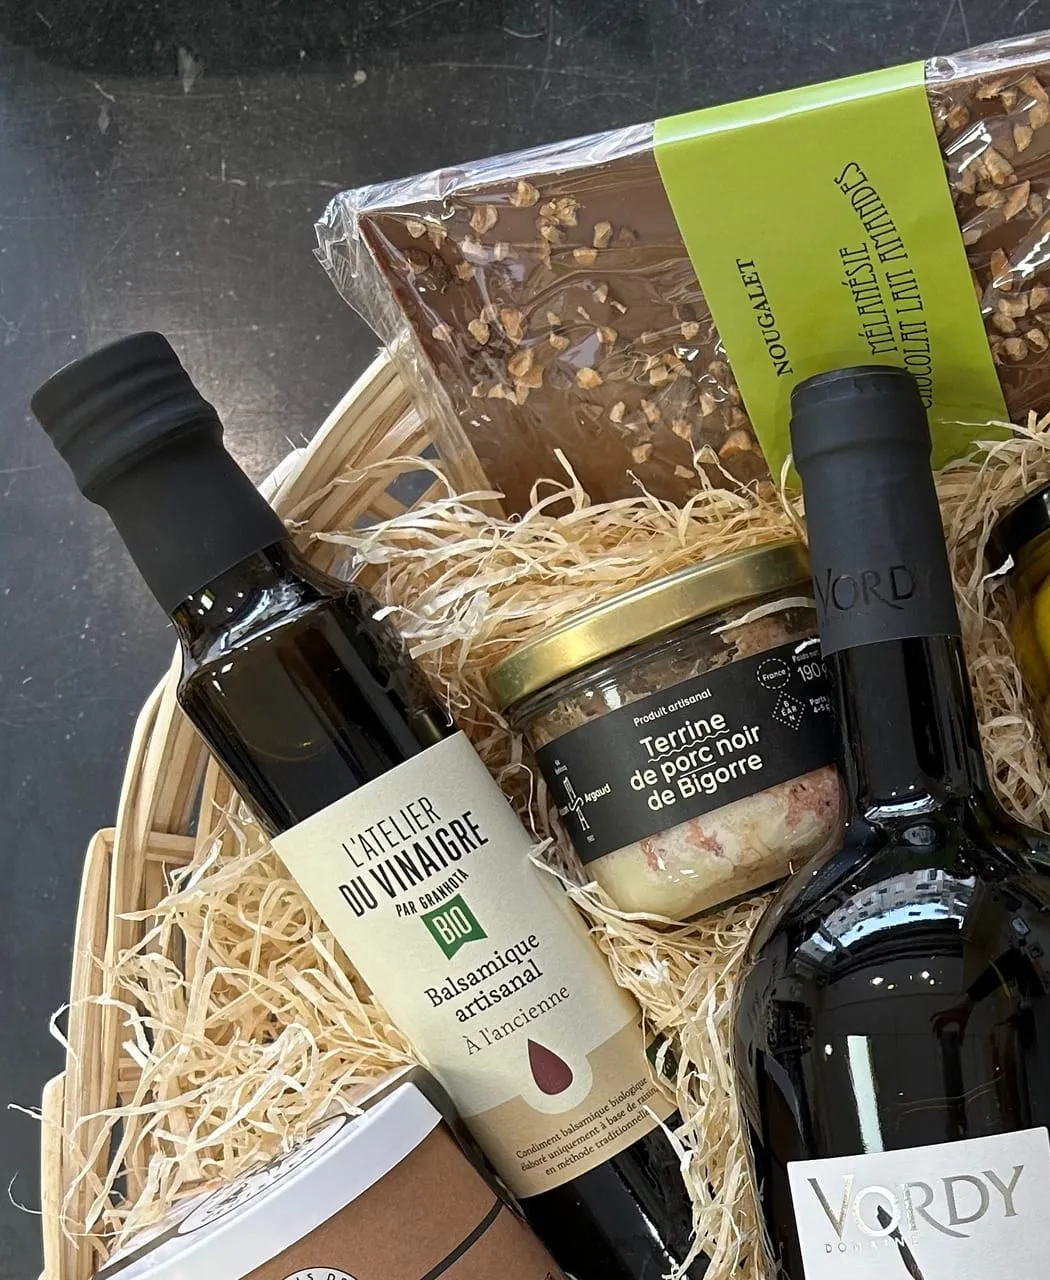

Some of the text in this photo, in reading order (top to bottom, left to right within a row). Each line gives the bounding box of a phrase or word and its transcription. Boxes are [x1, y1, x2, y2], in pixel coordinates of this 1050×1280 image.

[833, 162, 923, 314] LAIT AMANDES
[736, 259, 793, 376] NOUGALET
[839, 243, 897, 355] MÉLANÉSIE
[633, 688, 712, 727] Produit artisanal
[640, 712, 726, 757] Terrine
[630, 723, 760, 791] de porc noir
[648, 753, 763, 811] de Bigorre
[338, 810, 489, 917] DU VINAIGRE
[342, 796, 441, 868] L'ATELIER
[396, 868, 470, 918] PAR GRANHOTA
[432, 906, 472, 945] BIO
[424, 934, 540, 1008] Balsamique
[455, 958, 544, 1023] artisanal
[462, 986, 570, 1056] À l'ancienne
[516, 1077, 648, 1160] Condiment balsamique biologique
[521, 1109, 626, 1172] élaboré uniquement base
[557, 1109, 650, 1171] méthode traditionnelle
[807, 1164, 1025, 1241] VORDY
